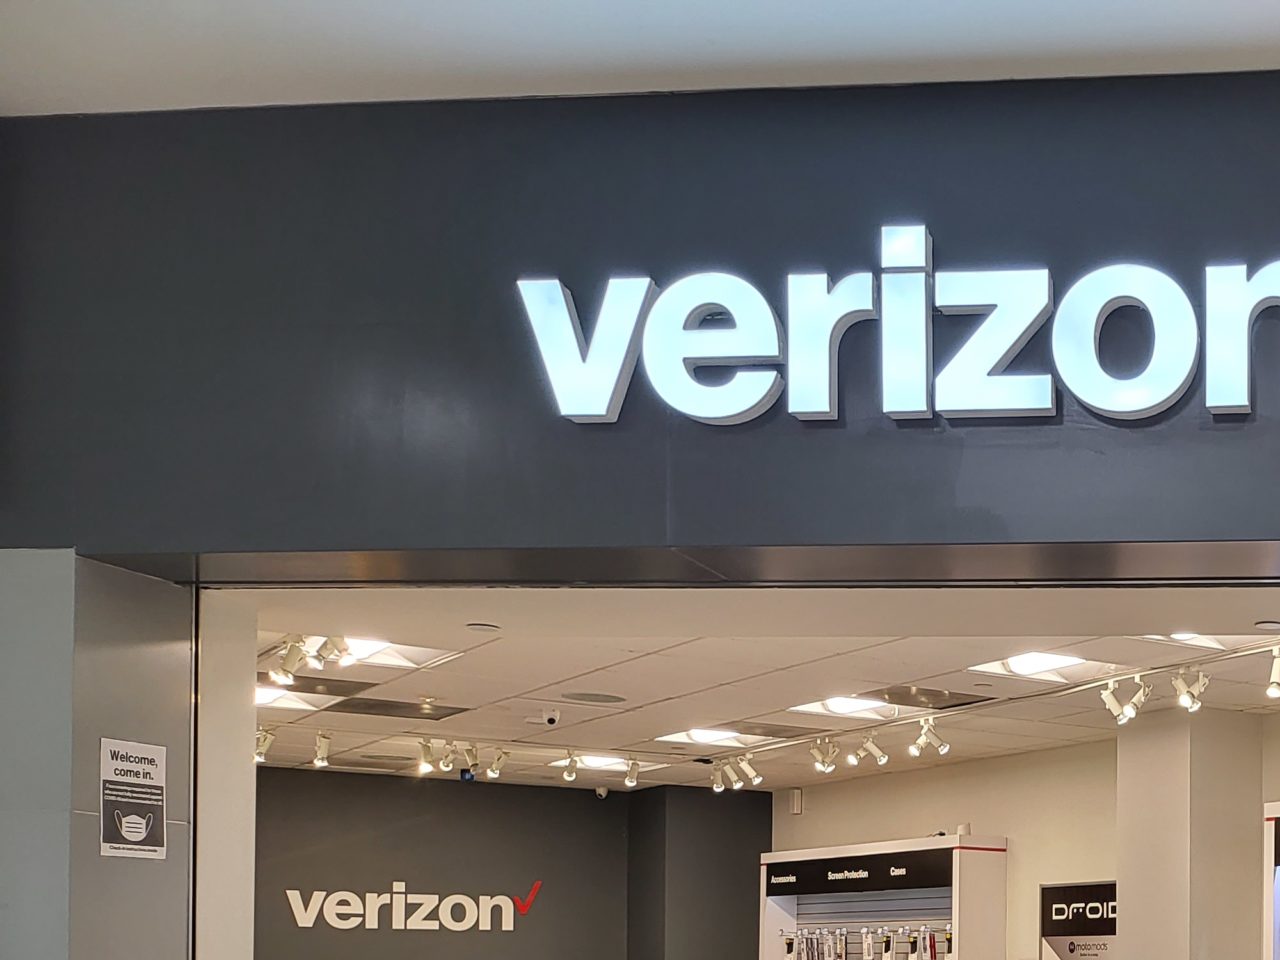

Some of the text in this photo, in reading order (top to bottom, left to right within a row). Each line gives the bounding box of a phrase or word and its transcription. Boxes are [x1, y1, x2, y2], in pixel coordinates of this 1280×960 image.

[109, 748, 158, 768] Welcome,
[113, 767, 154, 780] come in.
[827, 869, 869, 880] Screen Protection
[890, 866, 906, 876] Cases
[285, 881, 514, 932] verizon
